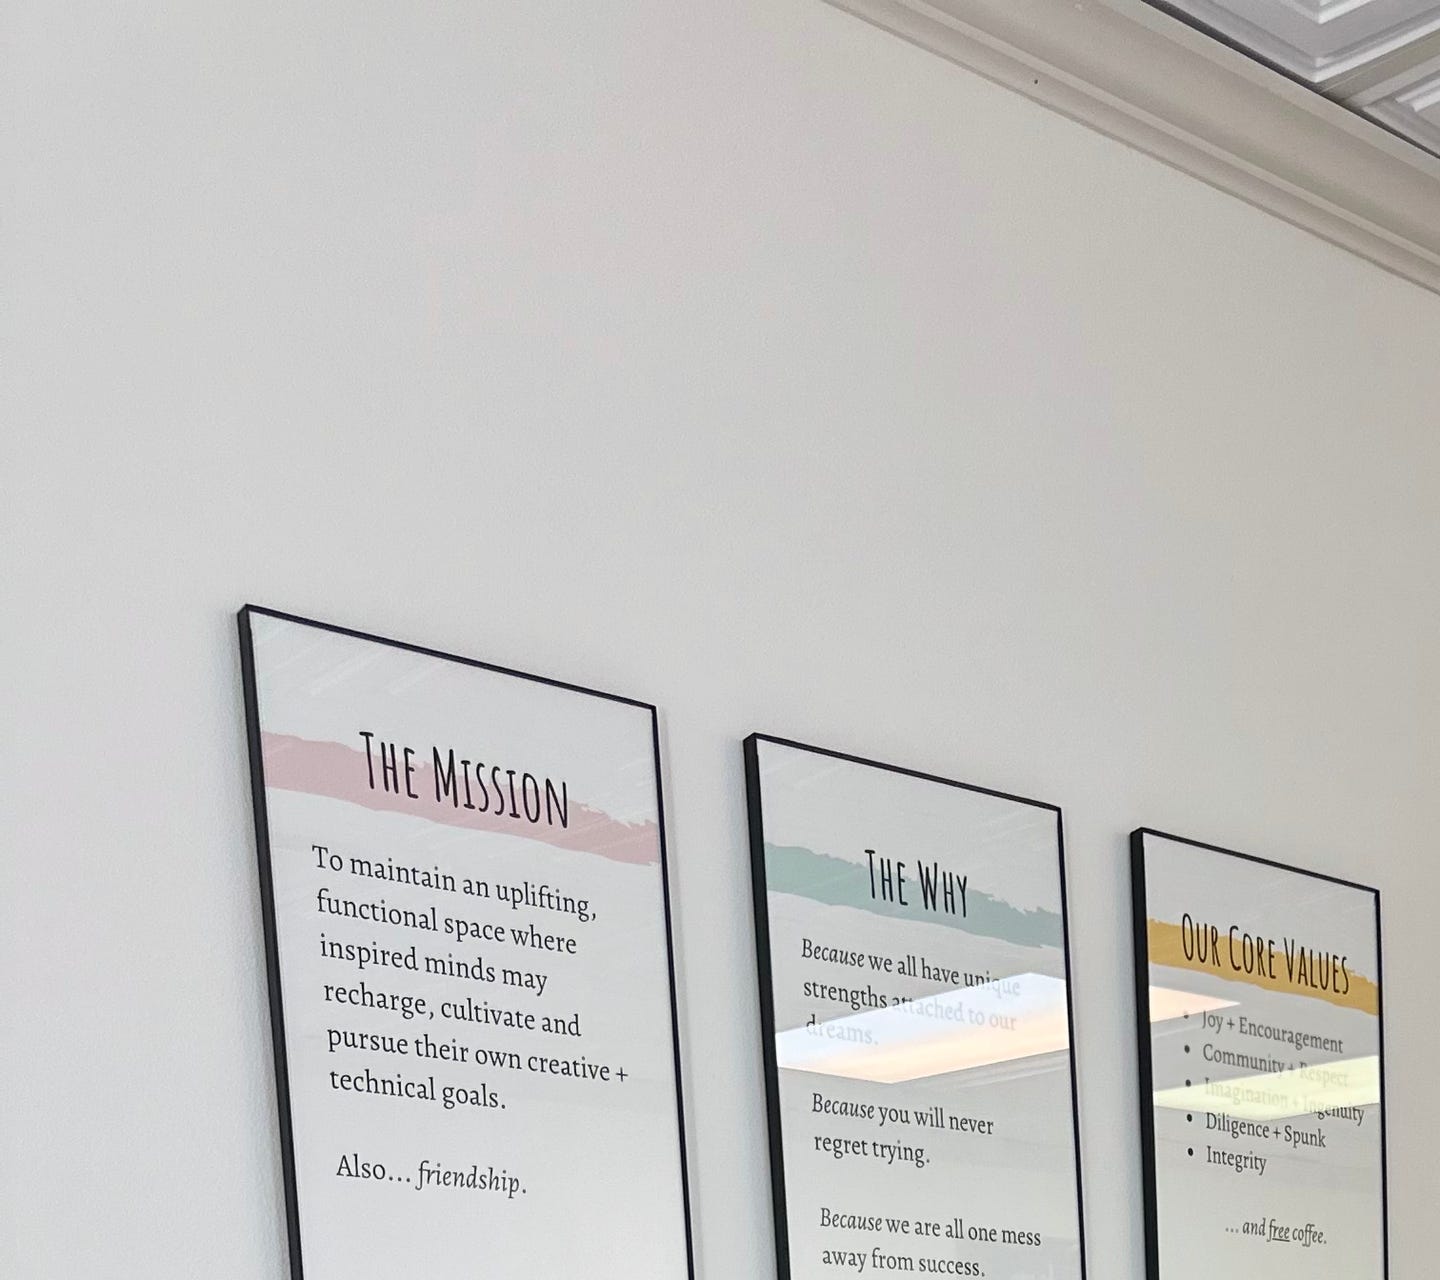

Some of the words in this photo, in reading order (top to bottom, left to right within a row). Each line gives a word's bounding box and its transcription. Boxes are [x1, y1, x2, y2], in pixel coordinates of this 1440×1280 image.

[311, 844, 344, 872] To
[349, 857, 457, 893] maintain
[462, 879, 491, 898] an
[495, 881, 597, 923] uplifting,
[316, 887, 439, 932] functional
[444, 917, 506, 943] space
[510, 923, 577, 955] where
[320, 932, 420, 972] inspired
[424, 953, 496, 983] minds
[501, 968, 548, 997] may
[801, 937, 865, 968] Because
[867, 954, 893, 973] we
[897, 954, 918, 978] all
[920, 957, 960, 986] have
[963, 966, 1023, 1001] unique
[323, 981, 434, 1021] recharge,
[441, 997, 536, 1031] cultivate
[541, 1013, 582, 1037] and
[803, 981, 888, 1012] strengths
[890, 991, 965, 1024] attached
[1200, 1009, 1224, 1035] Joy
[1238, 1015, 1344, 1055] Encouragement
[327, 1028, 409, 1055] pursue
[414, 1033, 469, 1063] their
[474, 1049, 523, 1070] own
[527, 1055, 610, 1082] creative
[1202, 1043, 1286, 1077] Community
[329, 1068, 437, 1101] technical
[442, 1082, 506, 1110] goals.
[811, 1092, 875, 1120] Because
[877, 1106, 911, 1127] you
[913, 1106, 946, 1129] will
[948, 1115, 994, 1135] never
[1205, 1111, 1270, 1140] Diligence
[1284, 1124, 1326, 1149] Spunk
[814, 1136, 869, 1160] regret
[871, 1140, 930, 1169] trying.
[1206, 1145, 1267, 1176] Integrity
[414, 1159, 527, 1200] friendship.
[819, 1207, 883, 1232] Because
[885, 1218, 910, 1235] we
[914, 1221, 941, 1238] are
[945, 1217, 965, 1240] all
[967, 1226, 998, 1243] one
[1001, 1229, 1042, 1247] mess
[1242, 1217, 1267, 1237] and
[1266, 1218, 1291, 1243] free
[1291, 1223, 1327, 1248] coffee.
[822, 1250, 868, 1274] away
[871, 1246, 915, 1272] from
[918, 1258, 986, 1278] success.
